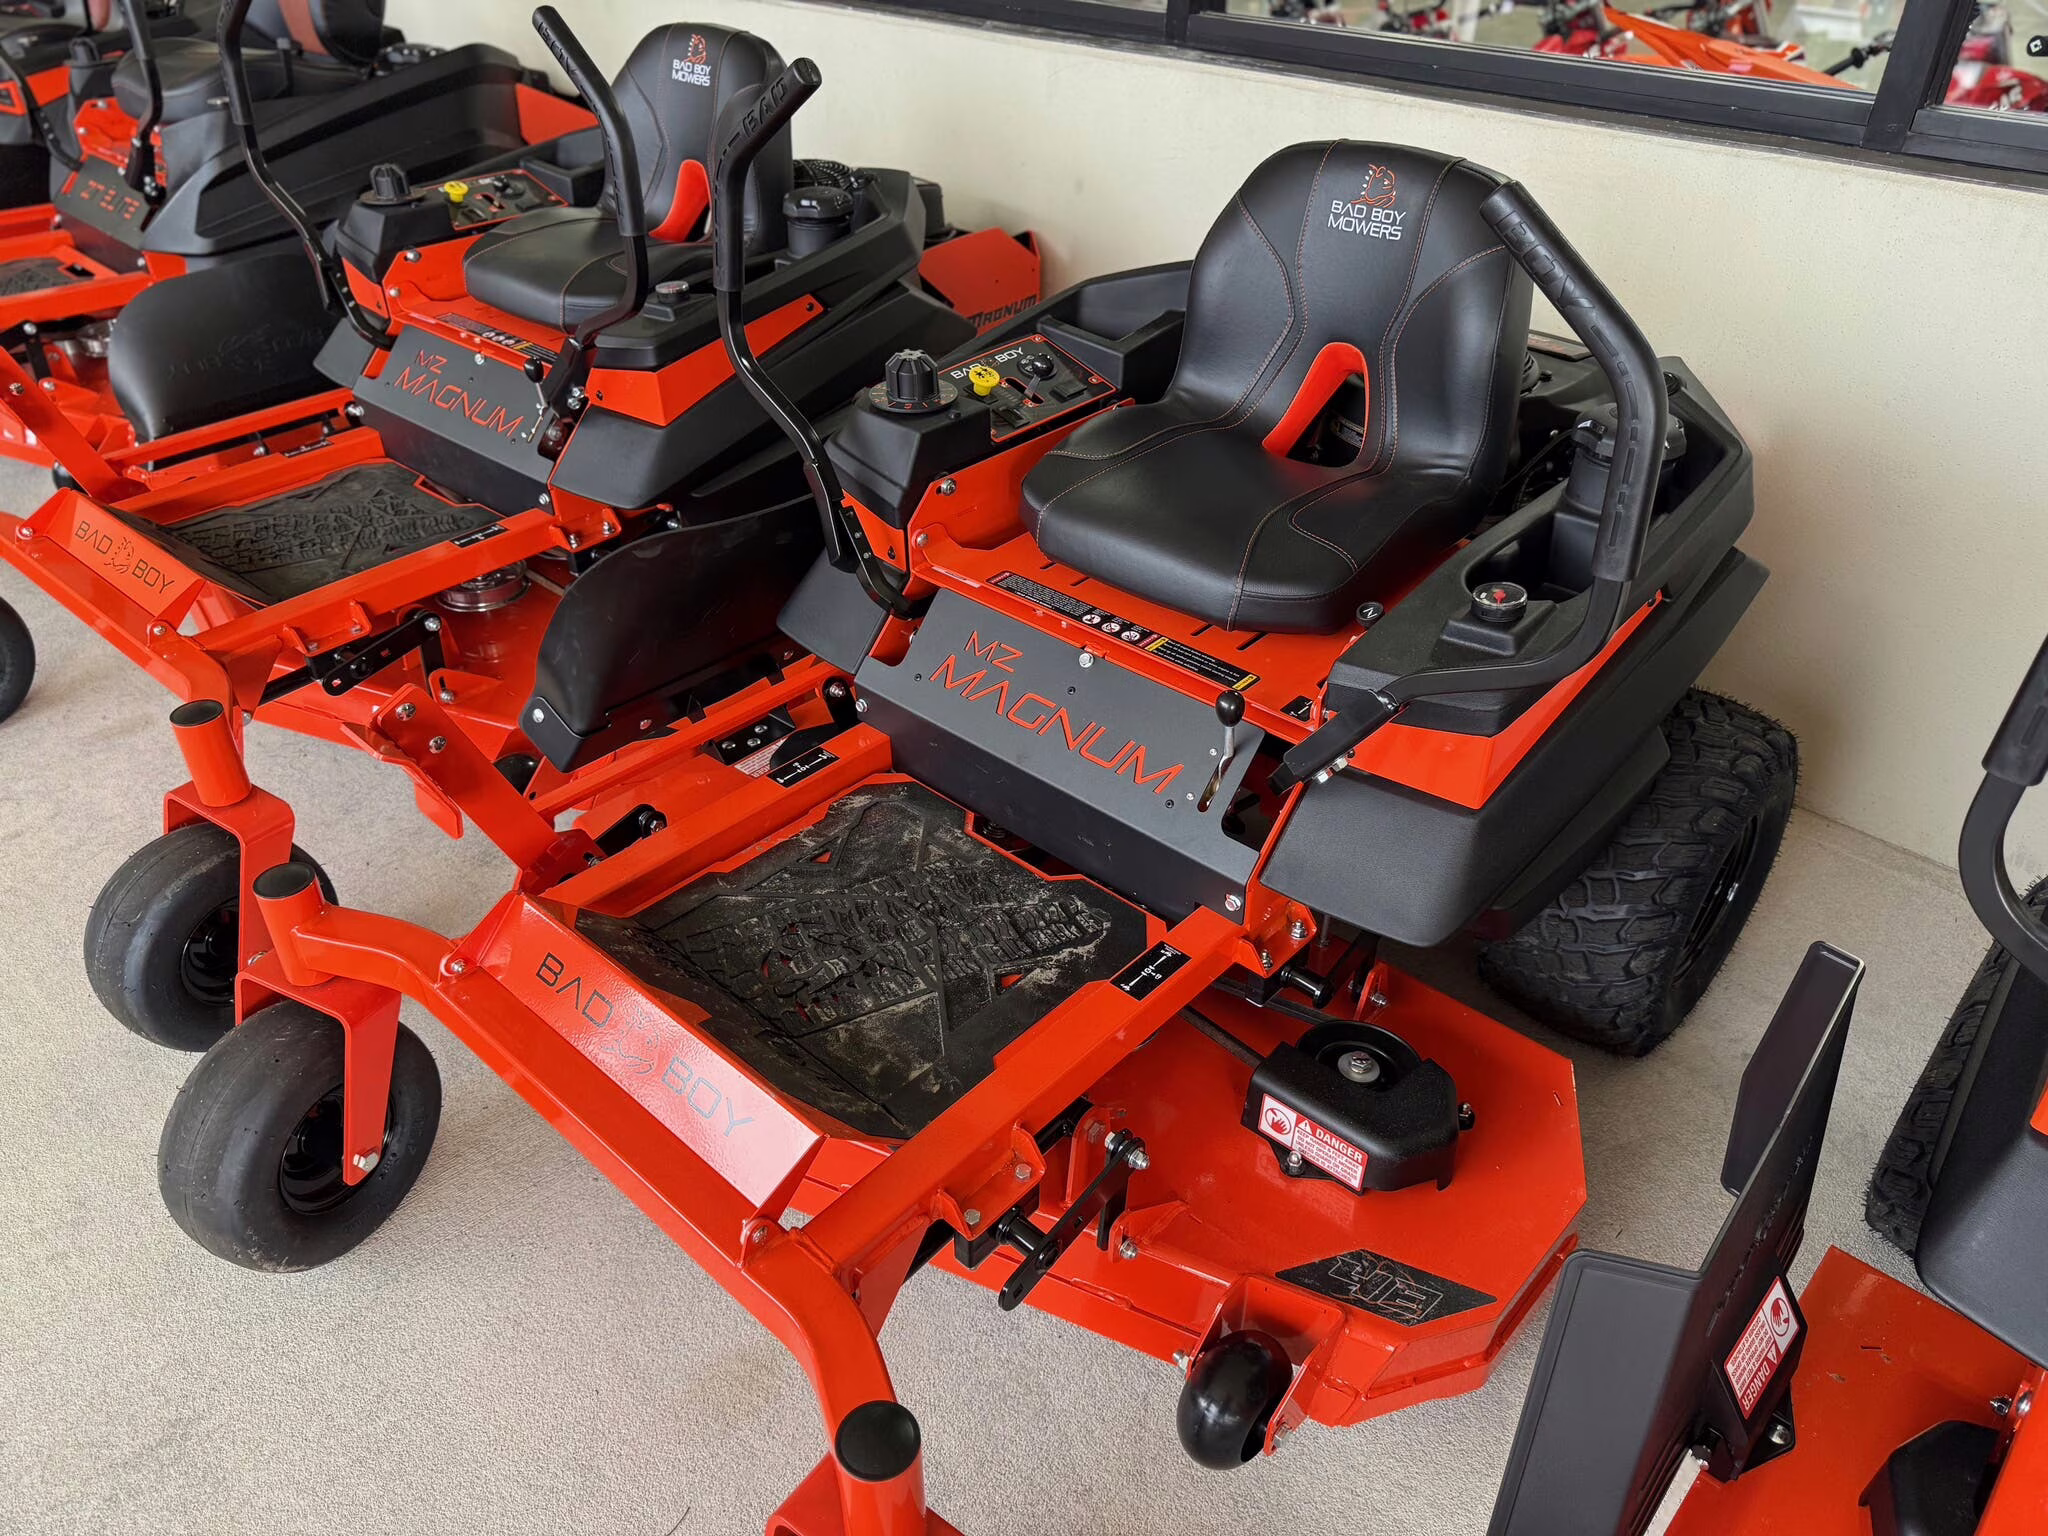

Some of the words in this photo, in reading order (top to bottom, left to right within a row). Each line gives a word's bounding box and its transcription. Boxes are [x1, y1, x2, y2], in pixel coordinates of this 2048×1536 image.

[671, 69, 710, 87] MOWERS
[673, 59, 692, 72] BAD
[694, 64, 711, 75] BOY
[1328, 213, 1402, 240] MOWERS
[1331, 200, 1366, 218] BAD
[1371, 208, 1406, 225] BOY
[416, 349, 447, 375] MZ
[994, 346, 1023, 363] BOY
[394, 366, 524, 438] MAGNUM
[75, 520, 113, 555] BAD
[132, 558, 175, 595] BOY
[964, 630, 1023, 673] MZ
[929, 653, 1184, 795] MAGNUM
[536, 951, 614, 1029] BAD
[661, 1056, 755, 1137] BOY
[1315, 1127, 1363, 1163] DANGER
[1741, 1359, 1770, 1412] DANGER
